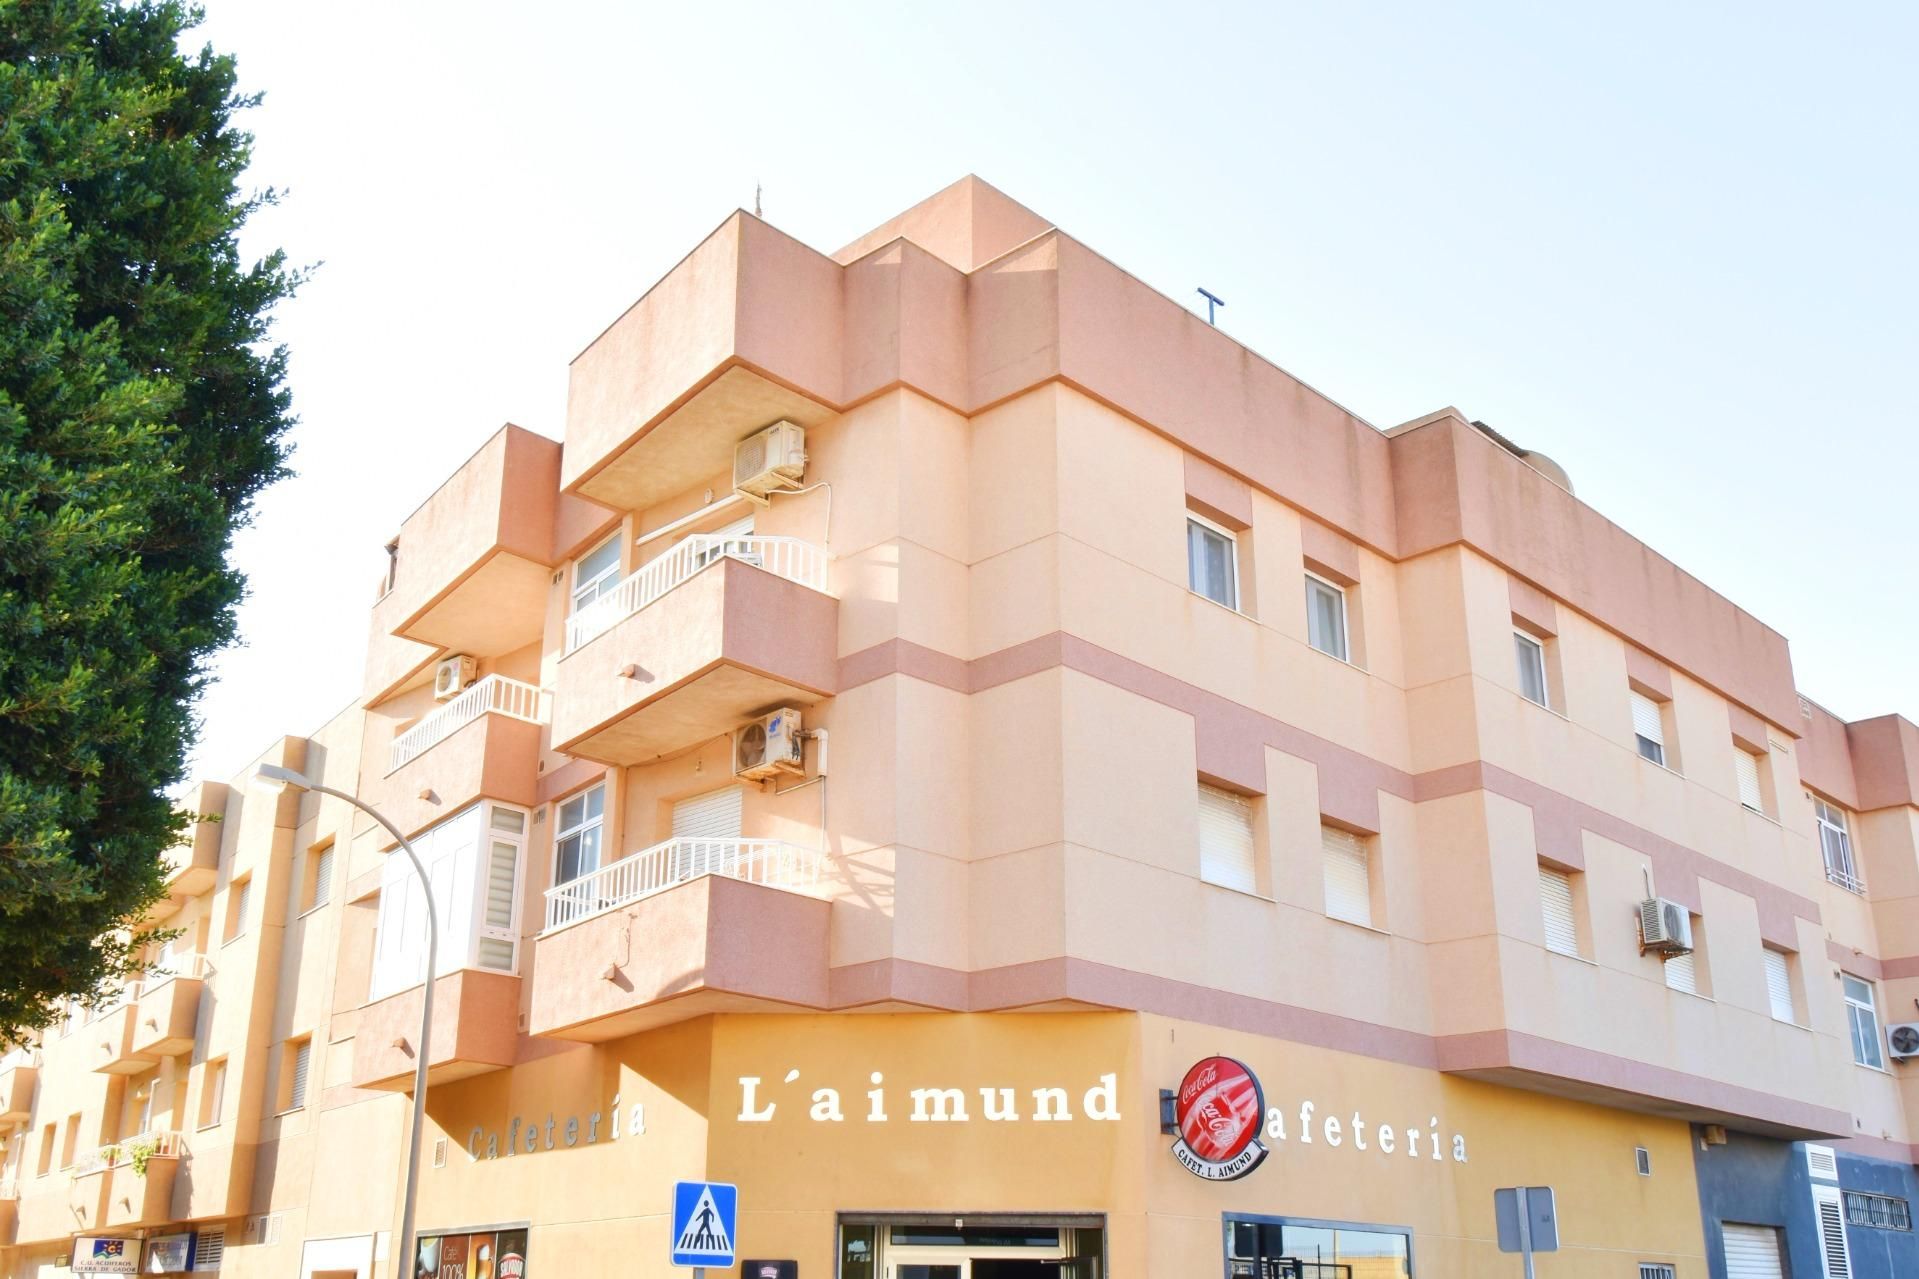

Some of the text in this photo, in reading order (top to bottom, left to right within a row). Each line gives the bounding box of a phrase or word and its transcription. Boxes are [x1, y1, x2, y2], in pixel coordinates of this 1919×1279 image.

[467, 1093, 647, 1163] Cafetería
[1266, 1100, 1468, 1163] afetería
[1178, 1149, 1252, 1178] CAFET. L. AIMUND
